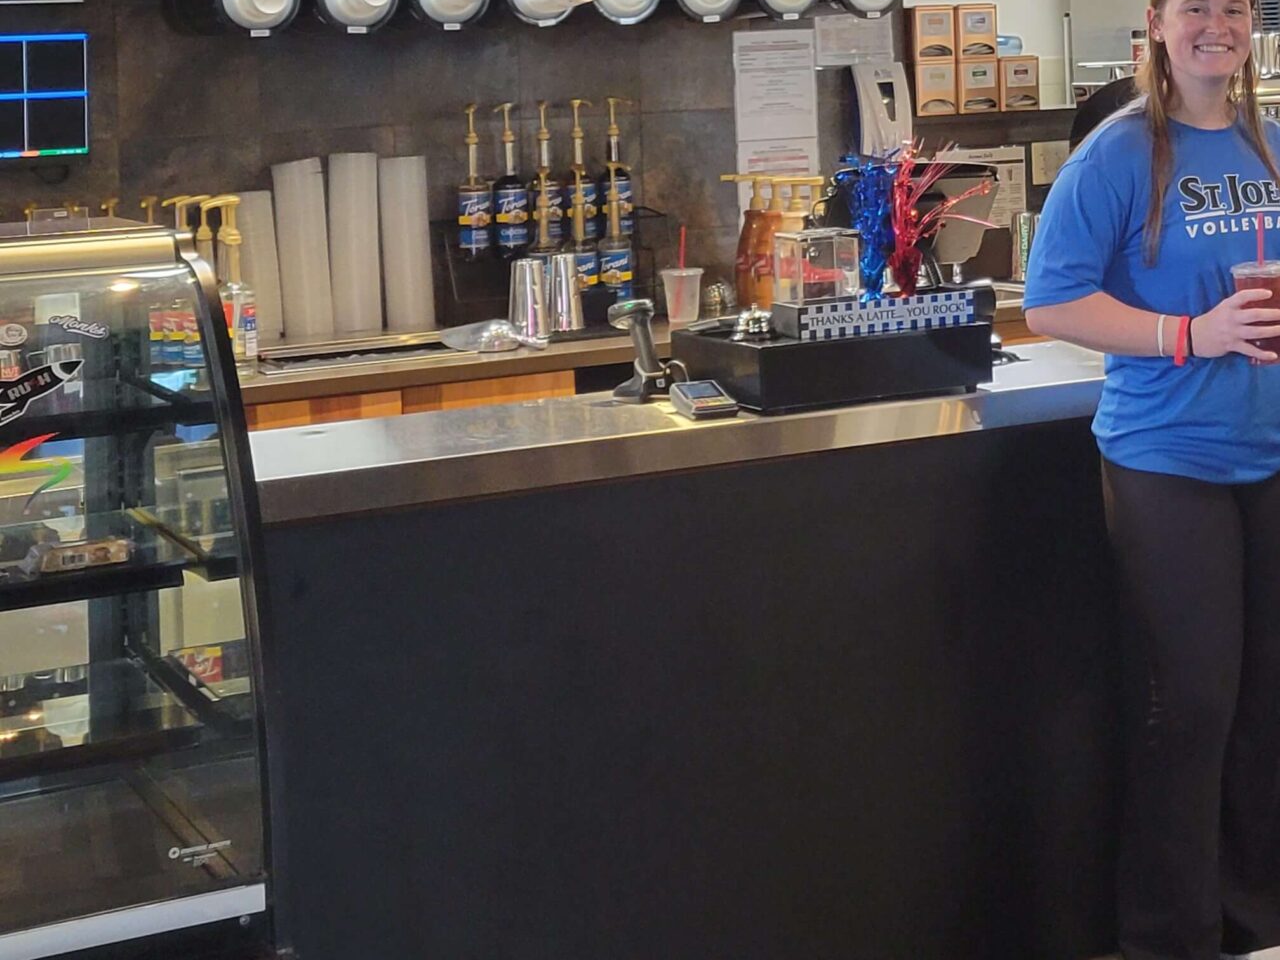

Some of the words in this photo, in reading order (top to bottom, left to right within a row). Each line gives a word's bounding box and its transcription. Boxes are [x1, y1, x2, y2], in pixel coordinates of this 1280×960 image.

[49, 315, 108, 338] Monks
[810, 313, 853, 327] THANKS
[856, 312, 864, 322] A
[907, 306, 930, 318] YOU
[933, 302, 965, 315] ROCK!
[7, 372, 51, 401] RUSH
